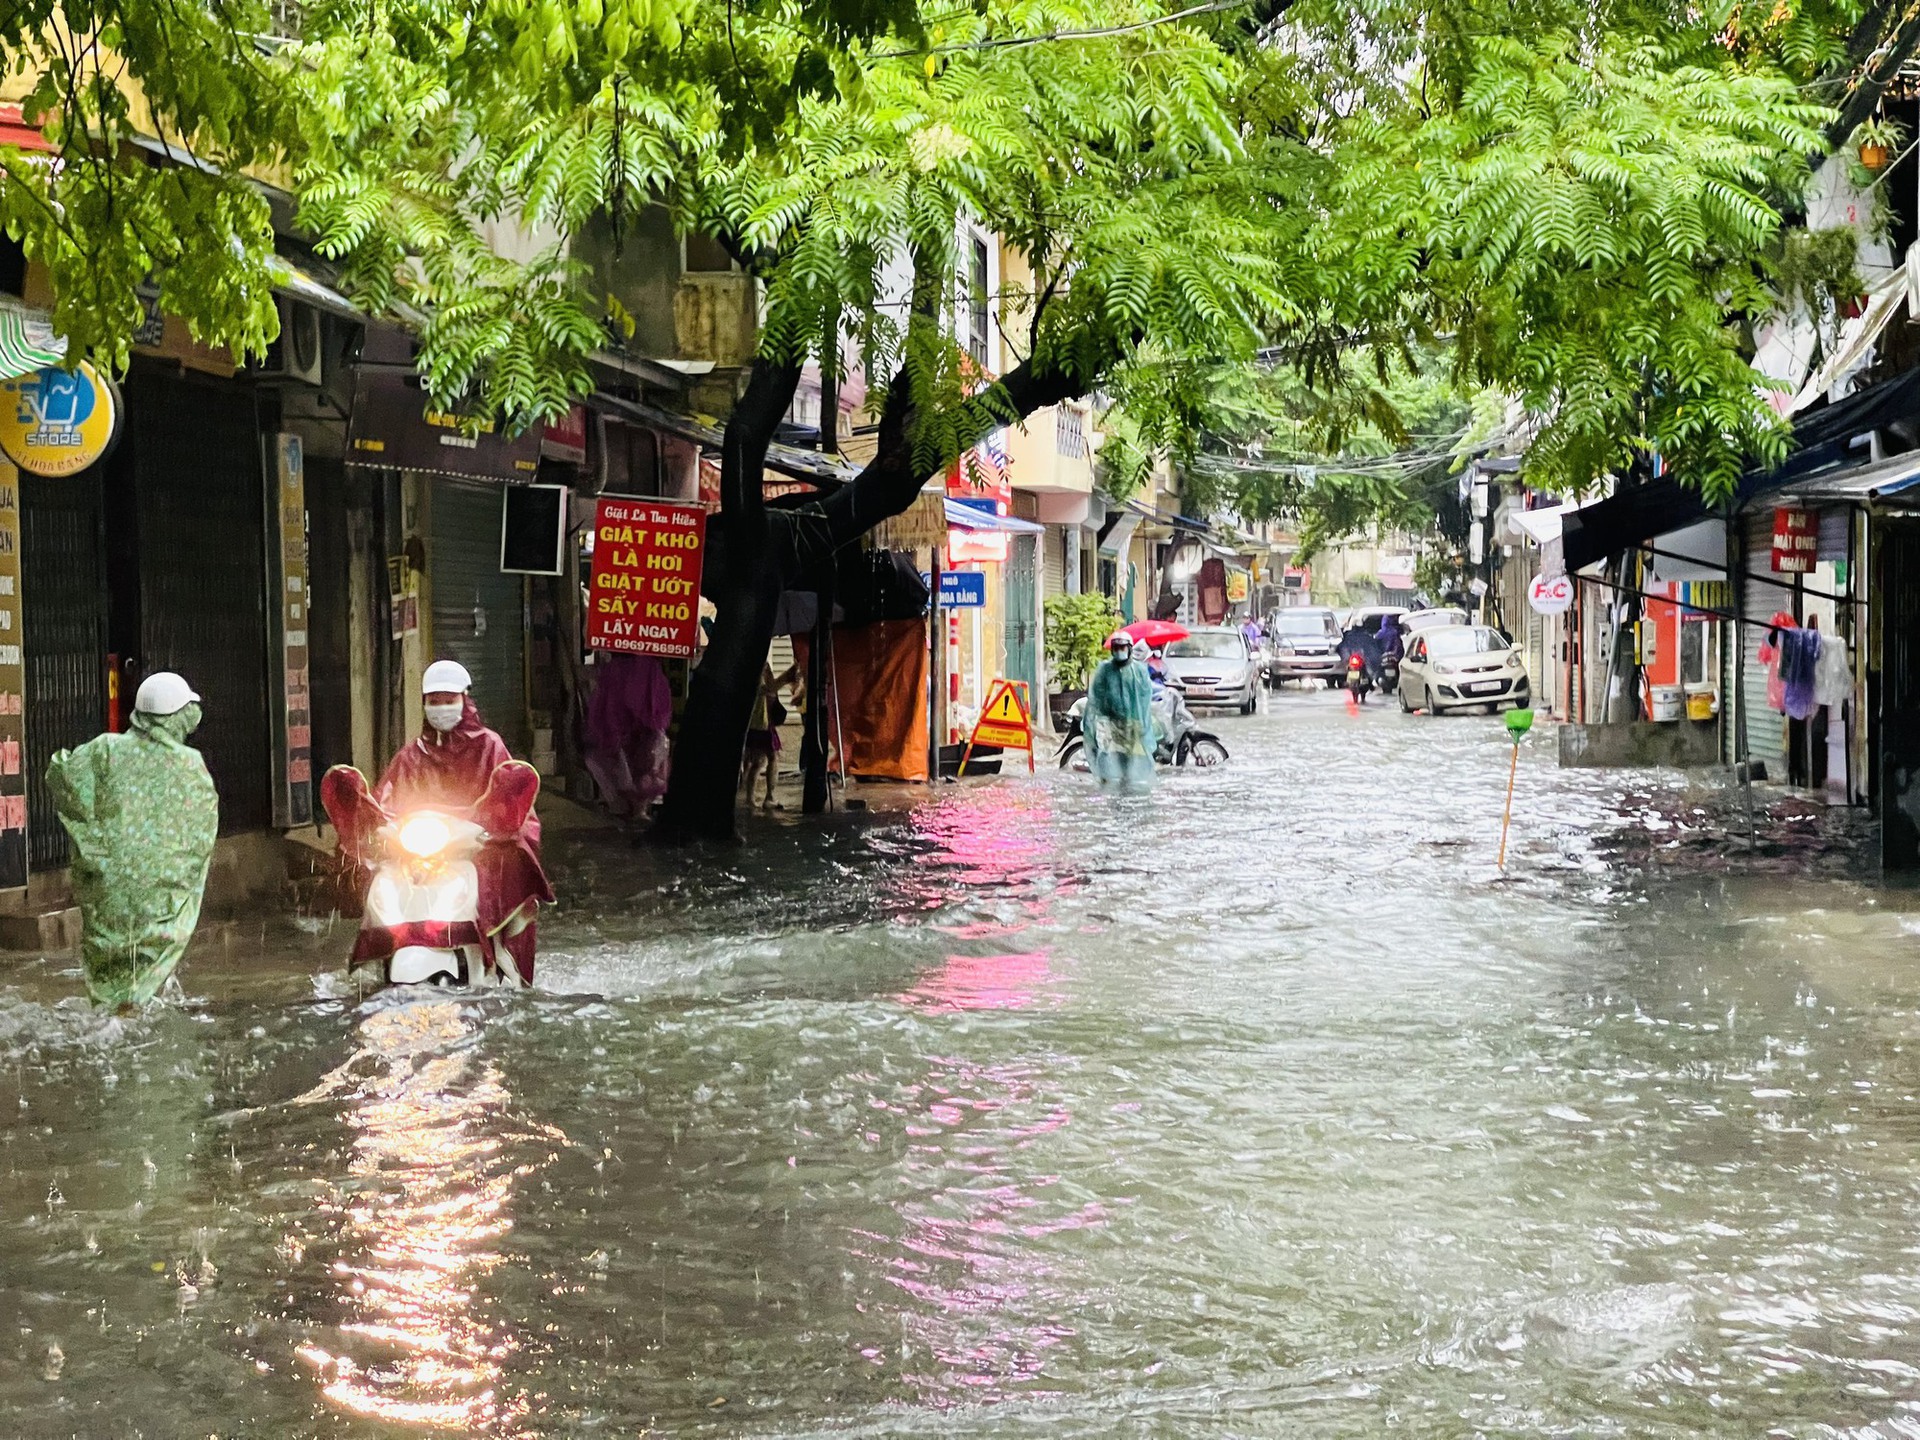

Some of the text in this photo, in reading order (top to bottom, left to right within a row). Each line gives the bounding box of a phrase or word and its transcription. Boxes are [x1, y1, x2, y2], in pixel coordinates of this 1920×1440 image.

[26, 433, 82, 446] STORE
[650, 510, 668, 524] Thu
[600, 525, 699, 550] GIẶT KHÔ
[1795, 536, 1816, 550] ONG
[612, 548, 638, 567] LÀ
[597, 572, 694, 596] GIẶT ƯỚT
[1534, 582, 1568, 599] F&C
[938, 591, 955, 603] HOA
[597, 594, 690, 621] SẤY KHÔ
[603, 617, 679, 640] LẤY NGAY
[614, 638, 690, 655] 0969786950
